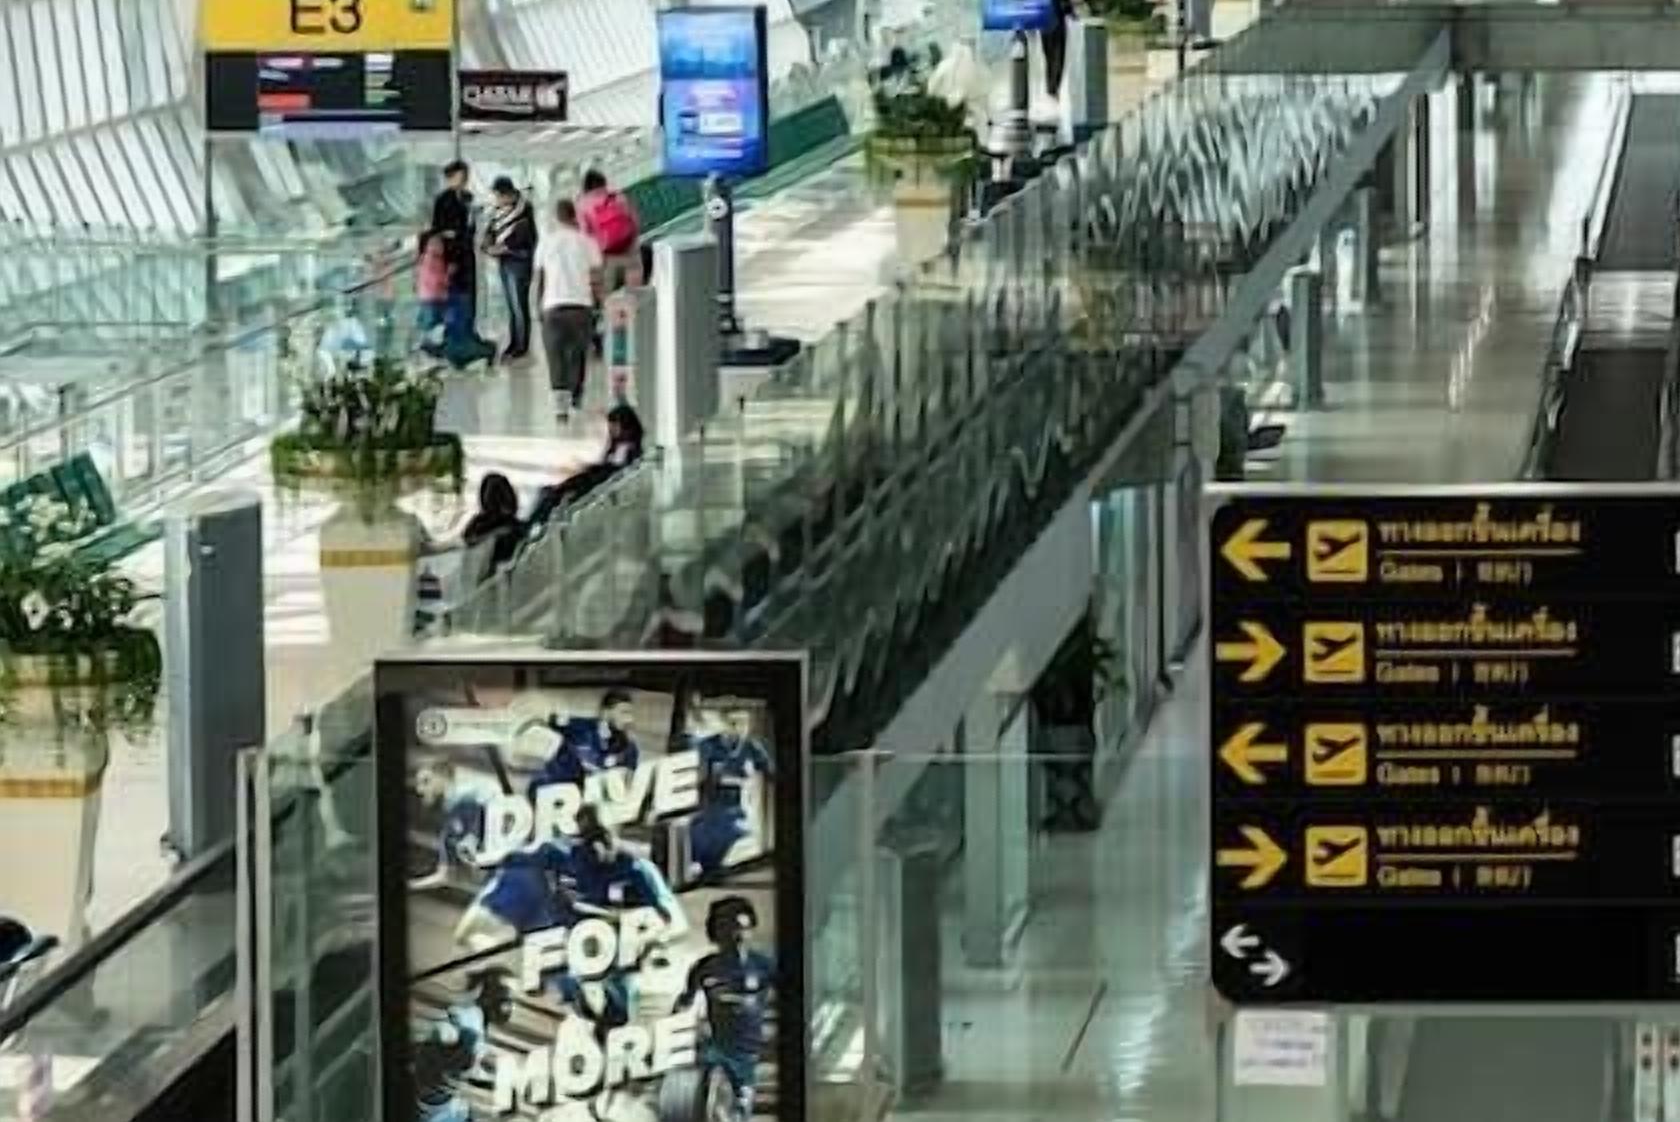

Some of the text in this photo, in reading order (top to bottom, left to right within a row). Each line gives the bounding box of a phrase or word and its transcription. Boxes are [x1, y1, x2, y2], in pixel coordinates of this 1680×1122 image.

[476, 750, 699, 866] DRIVE
[523, 906, 666, 990] FOR
[495, 1011, 697, 1112] MORE
